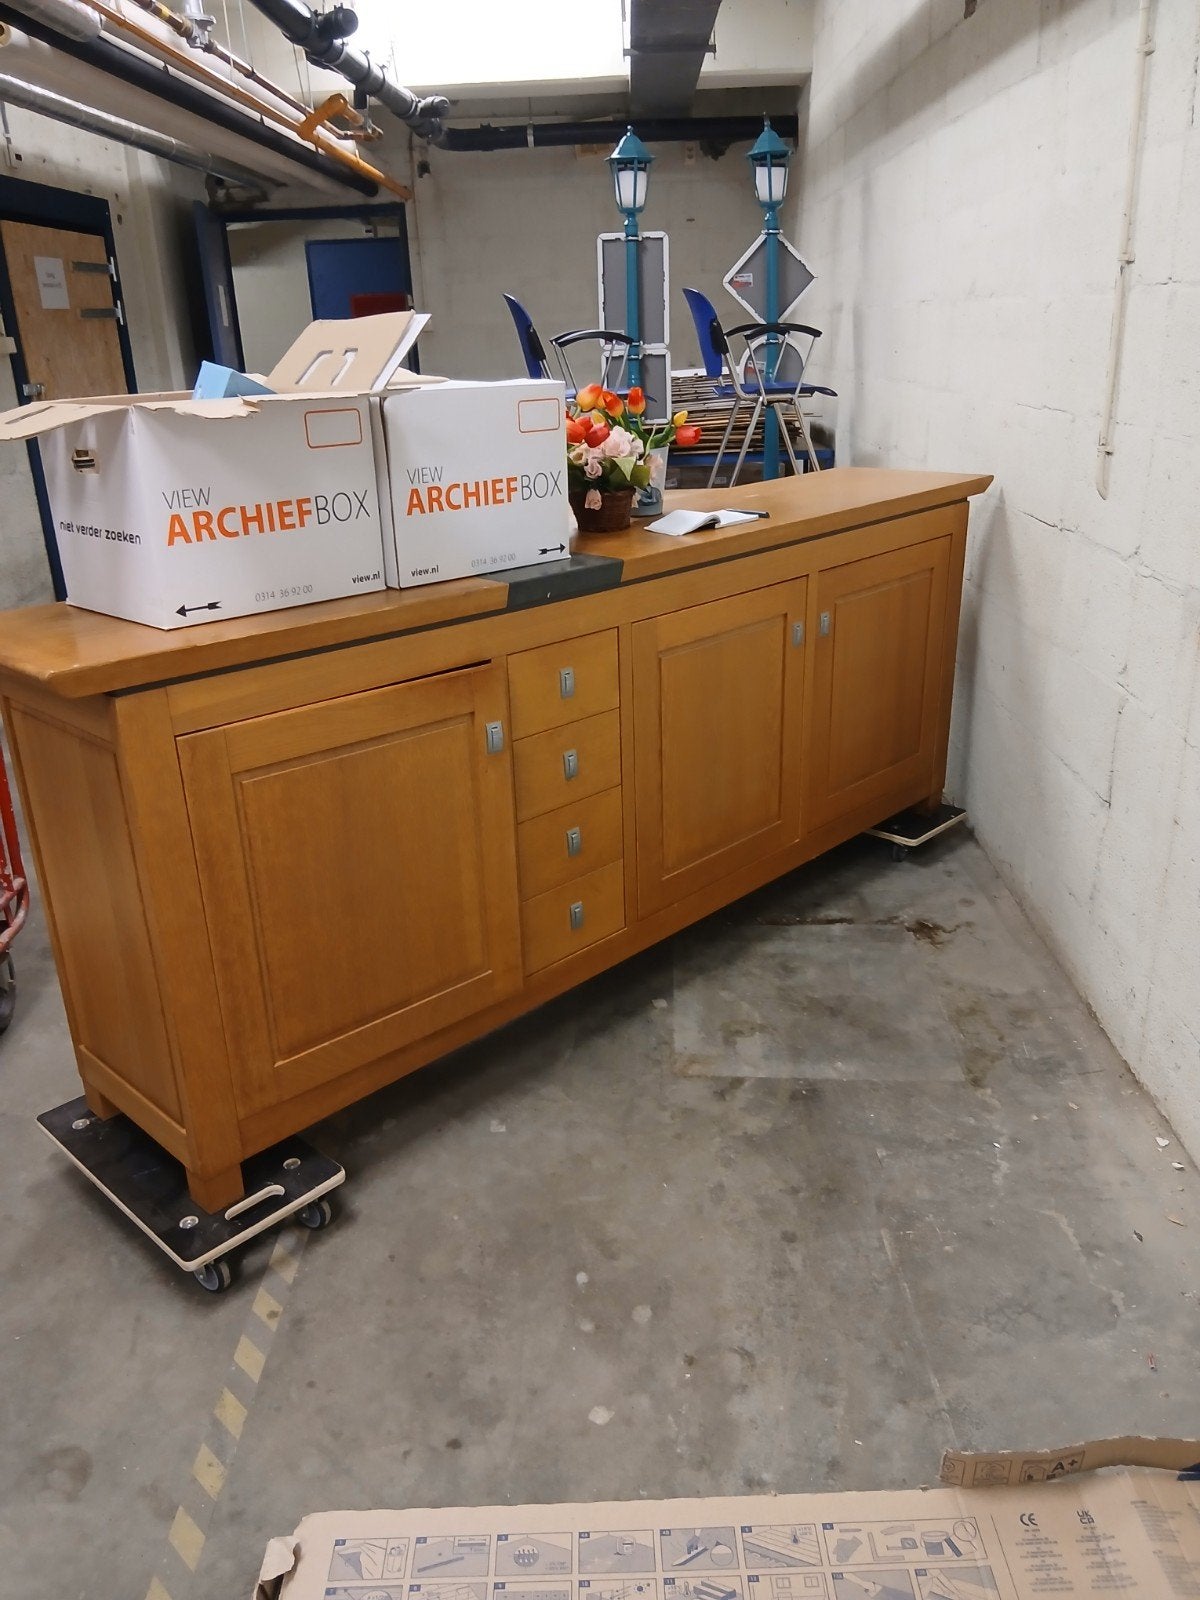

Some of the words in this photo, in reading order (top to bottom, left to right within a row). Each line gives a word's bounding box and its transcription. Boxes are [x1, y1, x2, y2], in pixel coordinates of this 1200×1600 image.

[407, 466, 443, 485] VIEW
[162, 486, 212, 510] VIEW
[406, 470, 563, 516] ARCHIEFBOX
[166, 489, 372, 547] ARCHIEFBOX
[60, 521, 75, 533] niet
[76, 525, 103, 539] verder
[104, 529, 142, 545] zoeken
[351, 570, 381, 584] view.nl
[410, 564, 440, 577] view.nl
[254, 591, 276, 603] 0314
[279, 588, 290, 599] 36
[291, 586, 301, 596] 92
[302, 584, 314, 594] 00
[1019, 1512, 1039, 1527] CE
